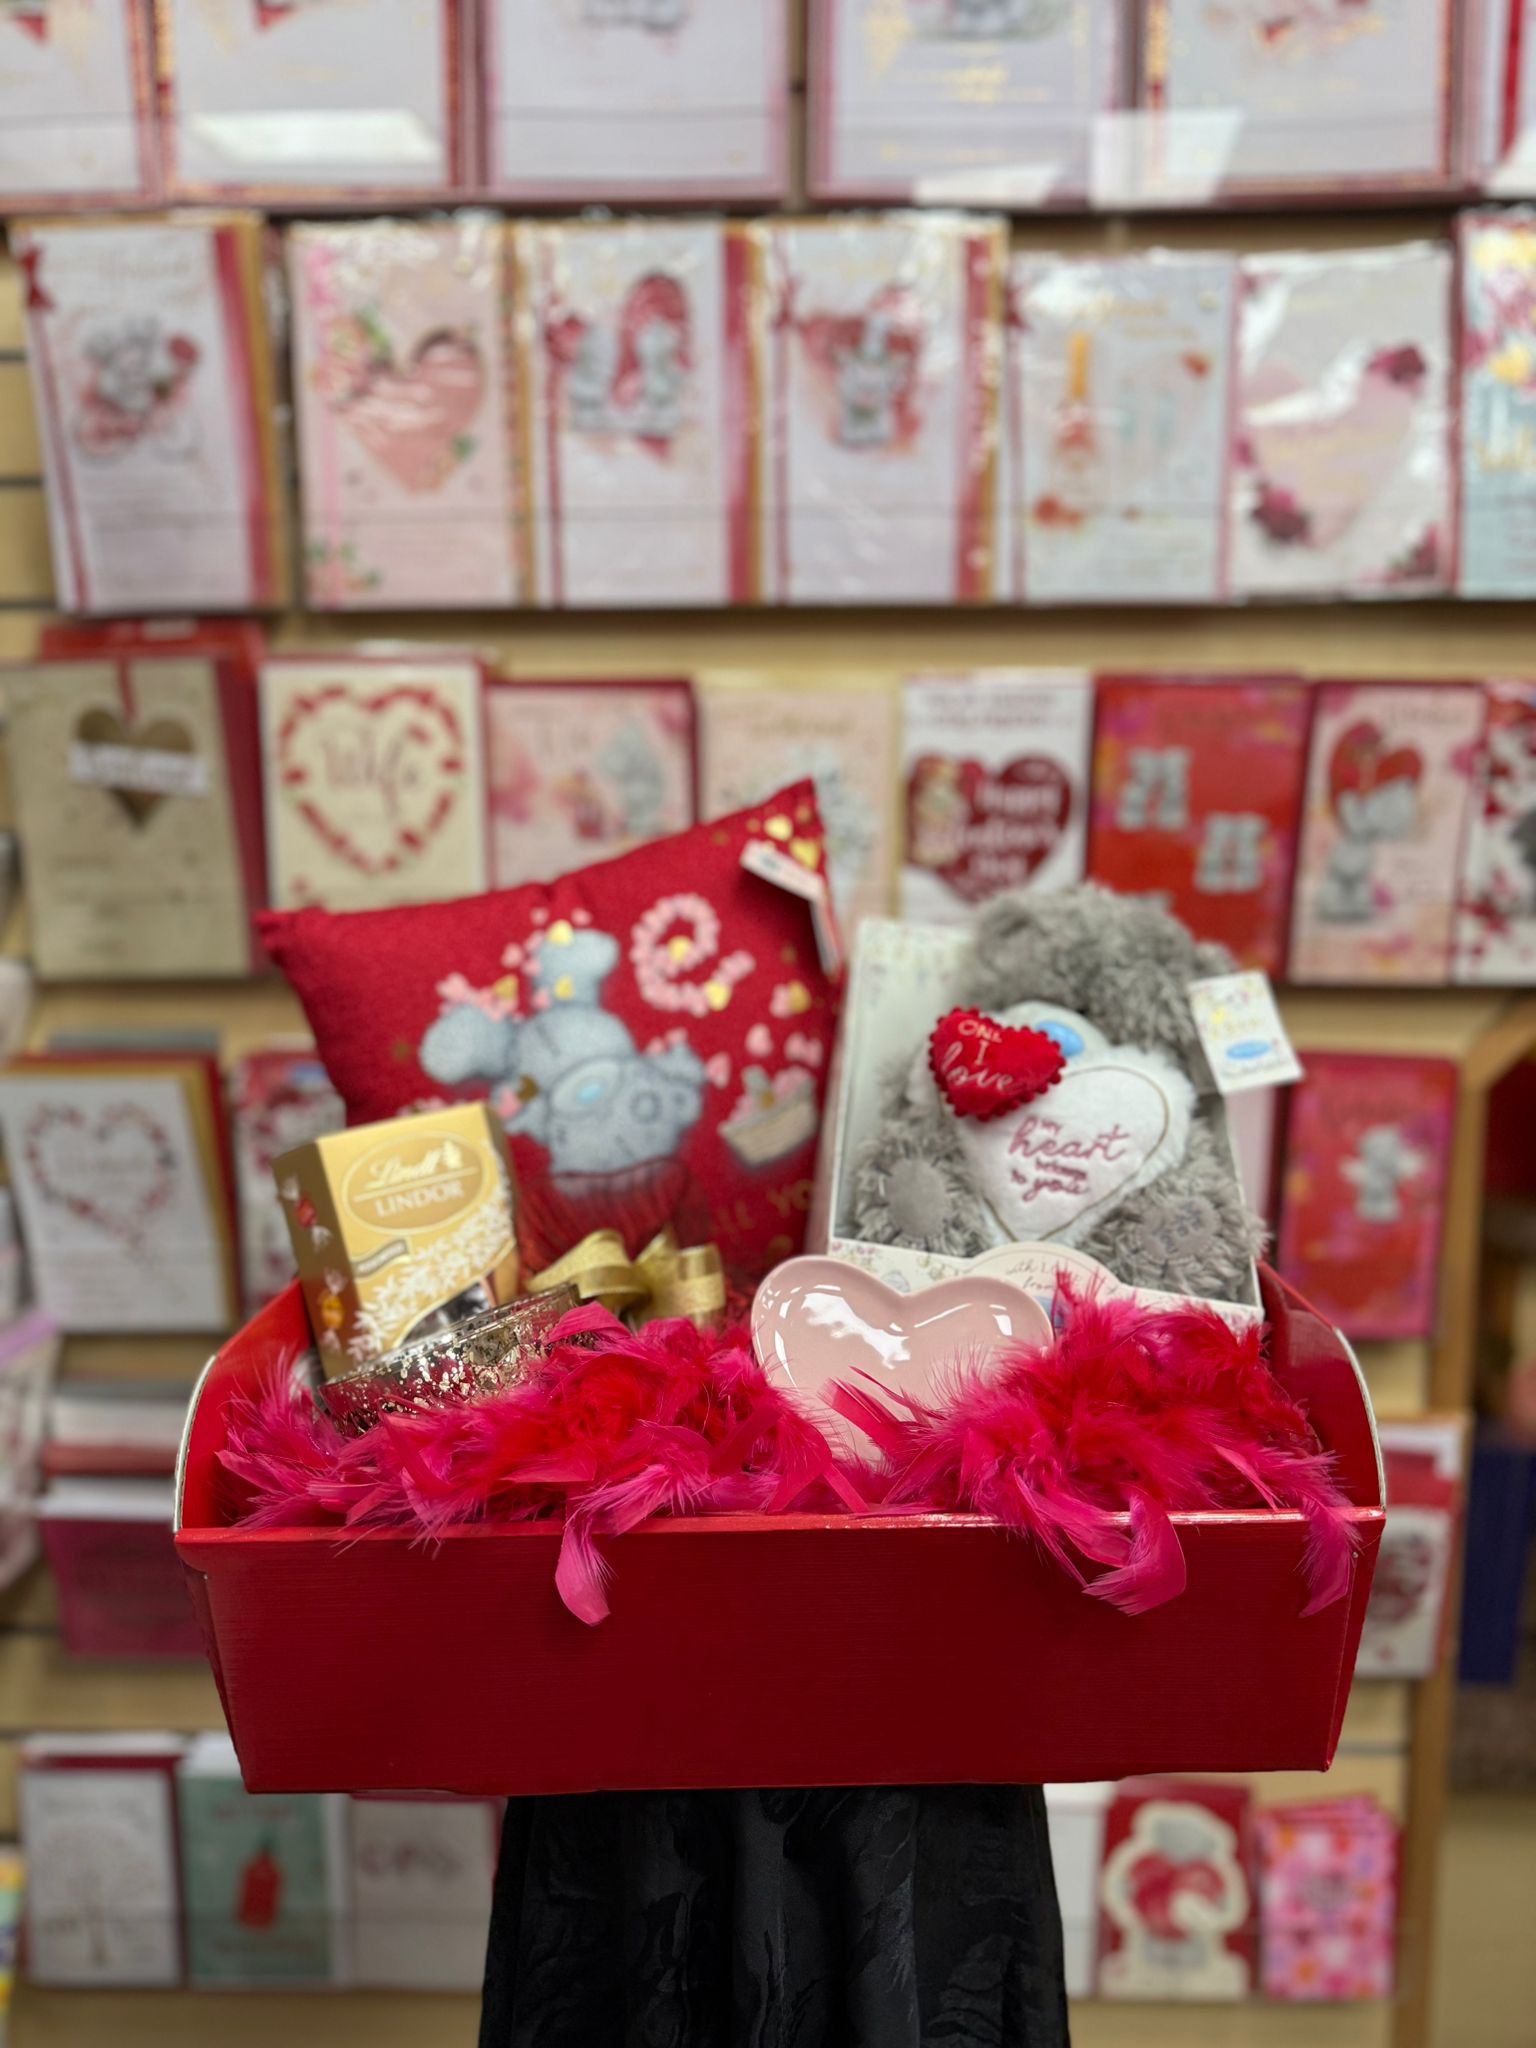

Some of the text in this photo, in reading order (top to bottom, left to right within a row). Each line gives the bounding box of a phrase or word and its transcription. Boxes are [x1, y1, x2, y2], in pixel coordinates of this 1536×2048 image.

[1010, 1115, 1130, 1162] heart
[365, 1149, 444, 1189] Lindt
[373, 1180, 465, 1218] LINDOR
[1022, 1176, 1091, 1202] you
